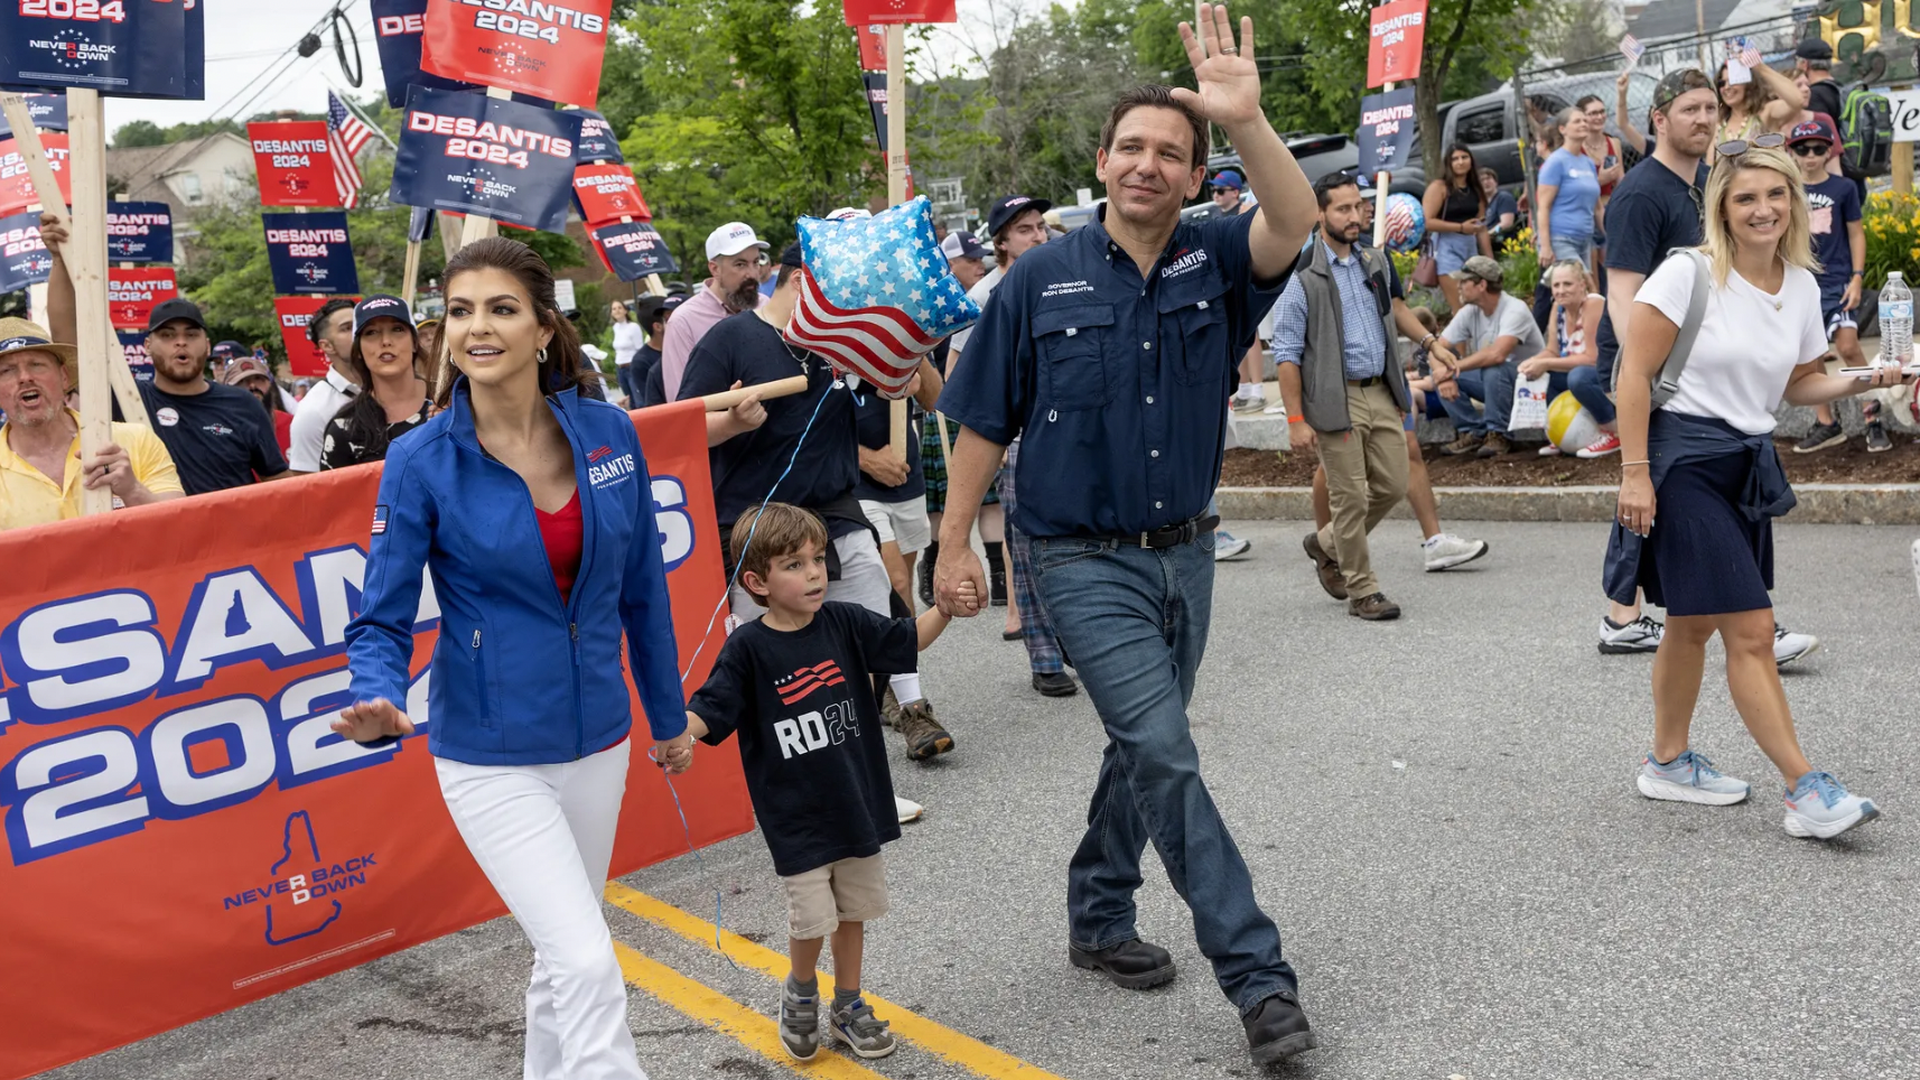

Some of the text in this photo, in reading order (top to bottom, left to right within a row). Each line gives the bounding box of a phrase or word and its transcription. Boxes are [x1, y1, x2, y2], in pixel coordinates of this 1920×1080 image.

[19, 0, 126, 23] 2024
[474, 10, 560, 44] 2024
[29, 39, 117, 54] NEVER BACK
[67, 50, 109, 61] DOWN
[516, 54, 547, 68] BACK
[506, 57, 540, 72] DOWN
[408, 110, 573, 158] DESANTIS
[253, 139, 328, 154] DESANTIS
[444, 138, 529, 169] 2024
[272, 154, 311, 168] 2024
[447, 174, 517, 193] NEVER BACK
[474, 184, 509, 198] DOWN
[596, 184, 629, 195] 2024
[266, 229, 347, 244] DESANTIS
[288, 243, 329, 257] 2024
[1161, 248, 1208, 278] DESANTIS
[1042, 286, 1094, 298] RON DESANTIS
[1047, 280, 1088, 290] GOVERNOR
[108, 290, 153, 302] 2024
[588, 453, 635, 486] ESANTIS
[773, 698, 860, 760] RD24
[223, 852, 378, 911] NEVER BACK
[292, 871, 366, 905] DOWN
